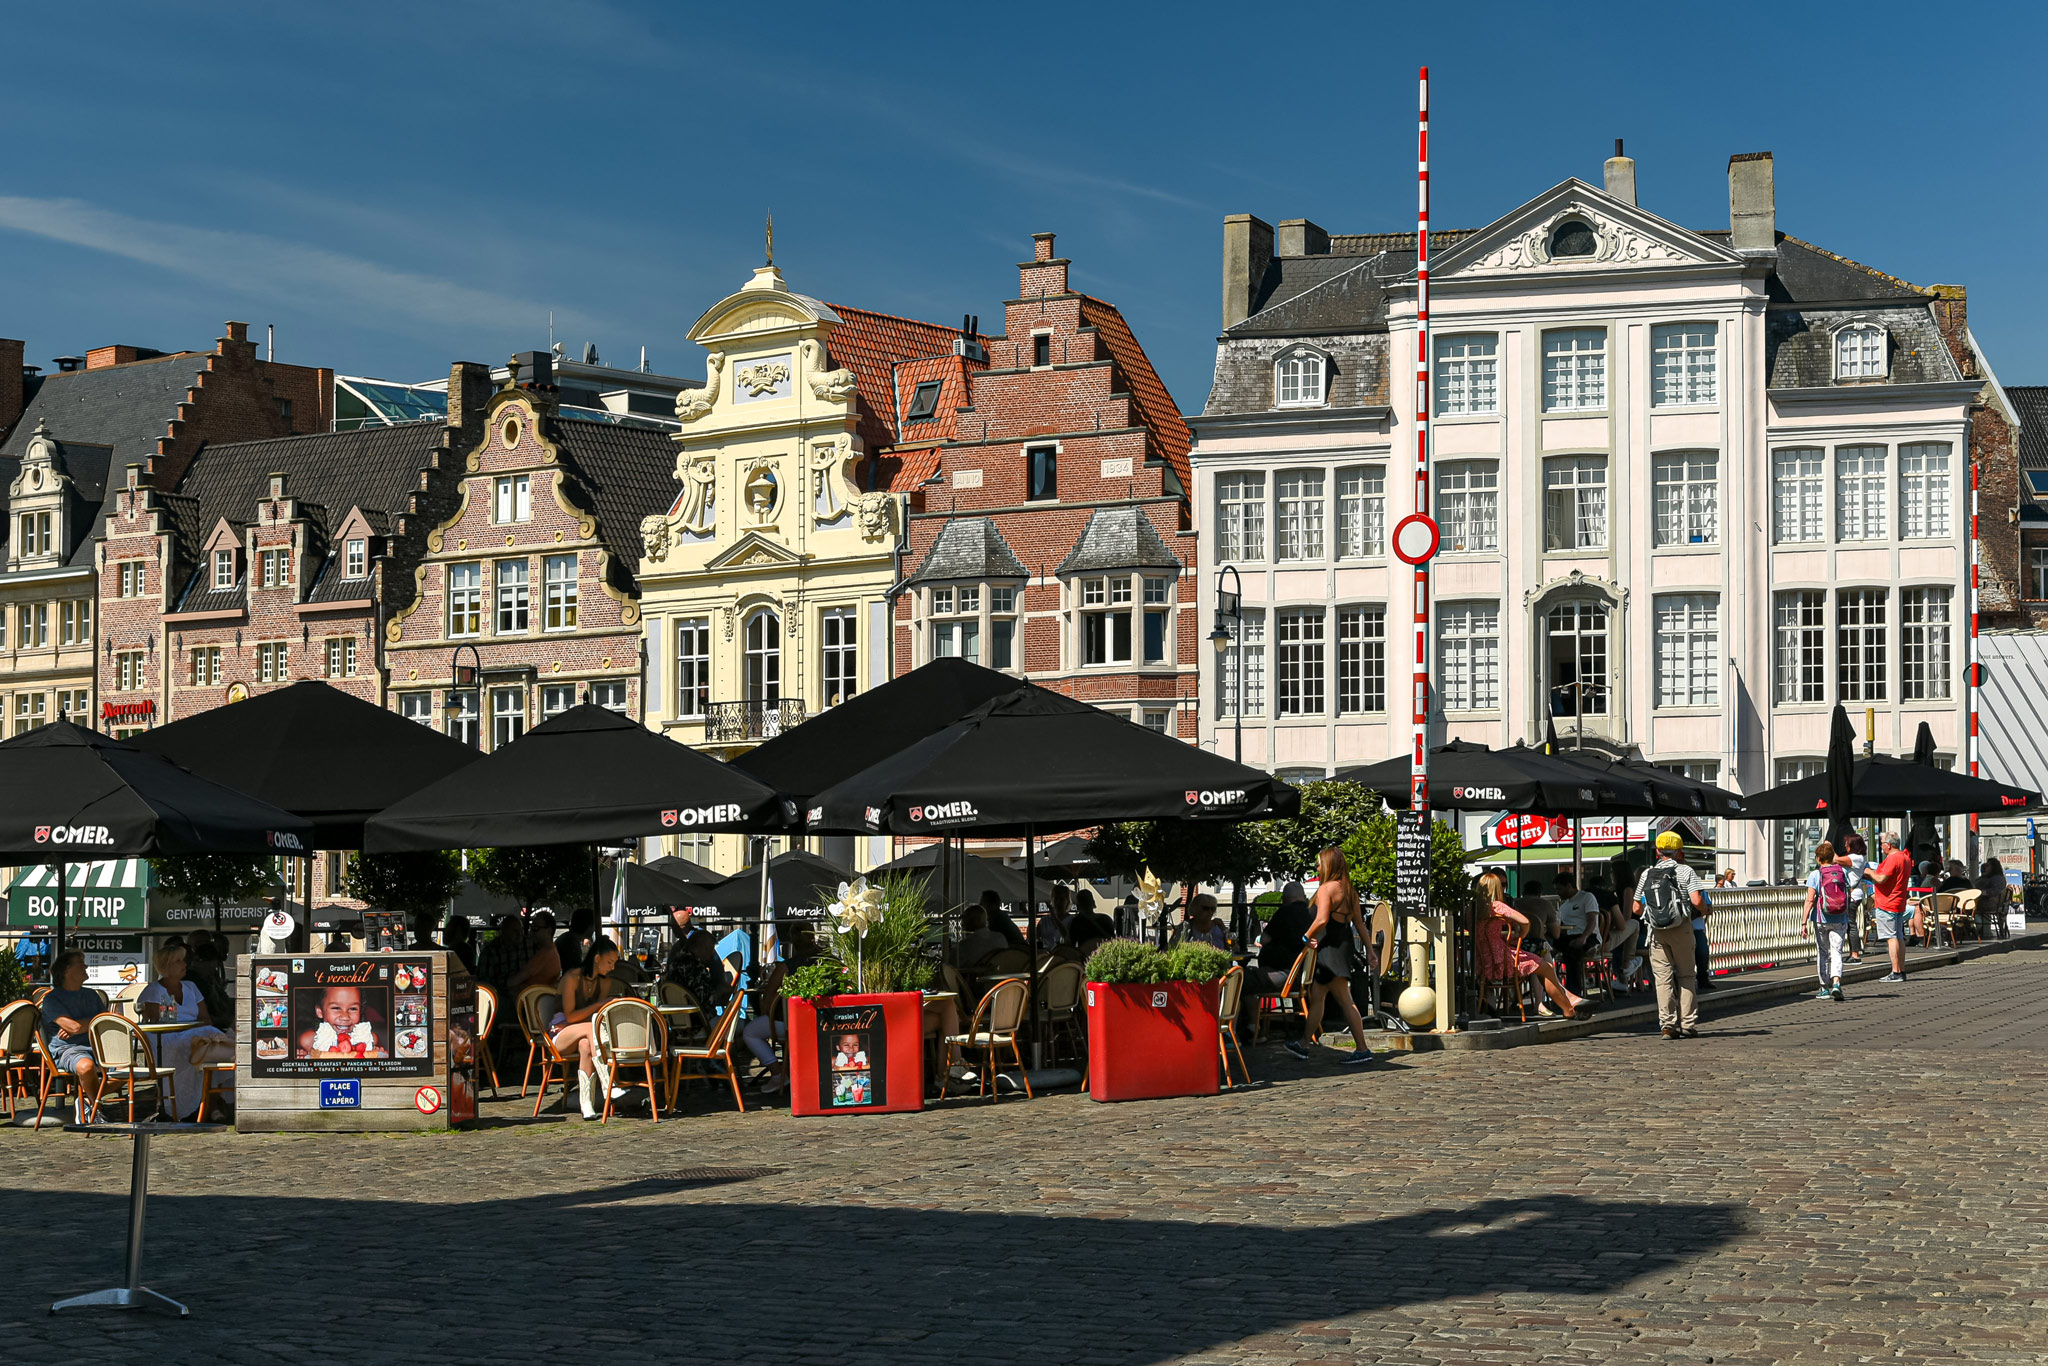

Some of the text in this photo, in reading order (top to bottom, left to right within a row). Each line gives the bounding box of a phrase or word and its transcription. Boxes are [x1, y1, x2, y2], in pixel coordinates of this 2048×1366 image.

[1104, 462, 1130, 475] 1934
[956, 476, 980, 486] ANNO
[100, 699, 154, 719] Marriott
[1199, 790, 1249, 805] OMER.
[1464, 787, 1506, 800] OMER.
[2001, 795, 2026, 806] Duvel
[680, 803, 749, 826] OMER.
[924, 801, 979, 821] OMER.
[51, 825, 115, 845] OMER.
[82, 897, 126, 918] TRIP
[692, 906, 720, 916] OMER.
[786, 906, 826, 916] Meraki
[77, 938, 123, 950] TICKETS
[326, 961, 376, 983] verschil
[329, 964, 356, 972] Graslei 1
[329, 1082, 351, 1090] PLACE
[325, 1096, 355, 1105] L'APÉRO
